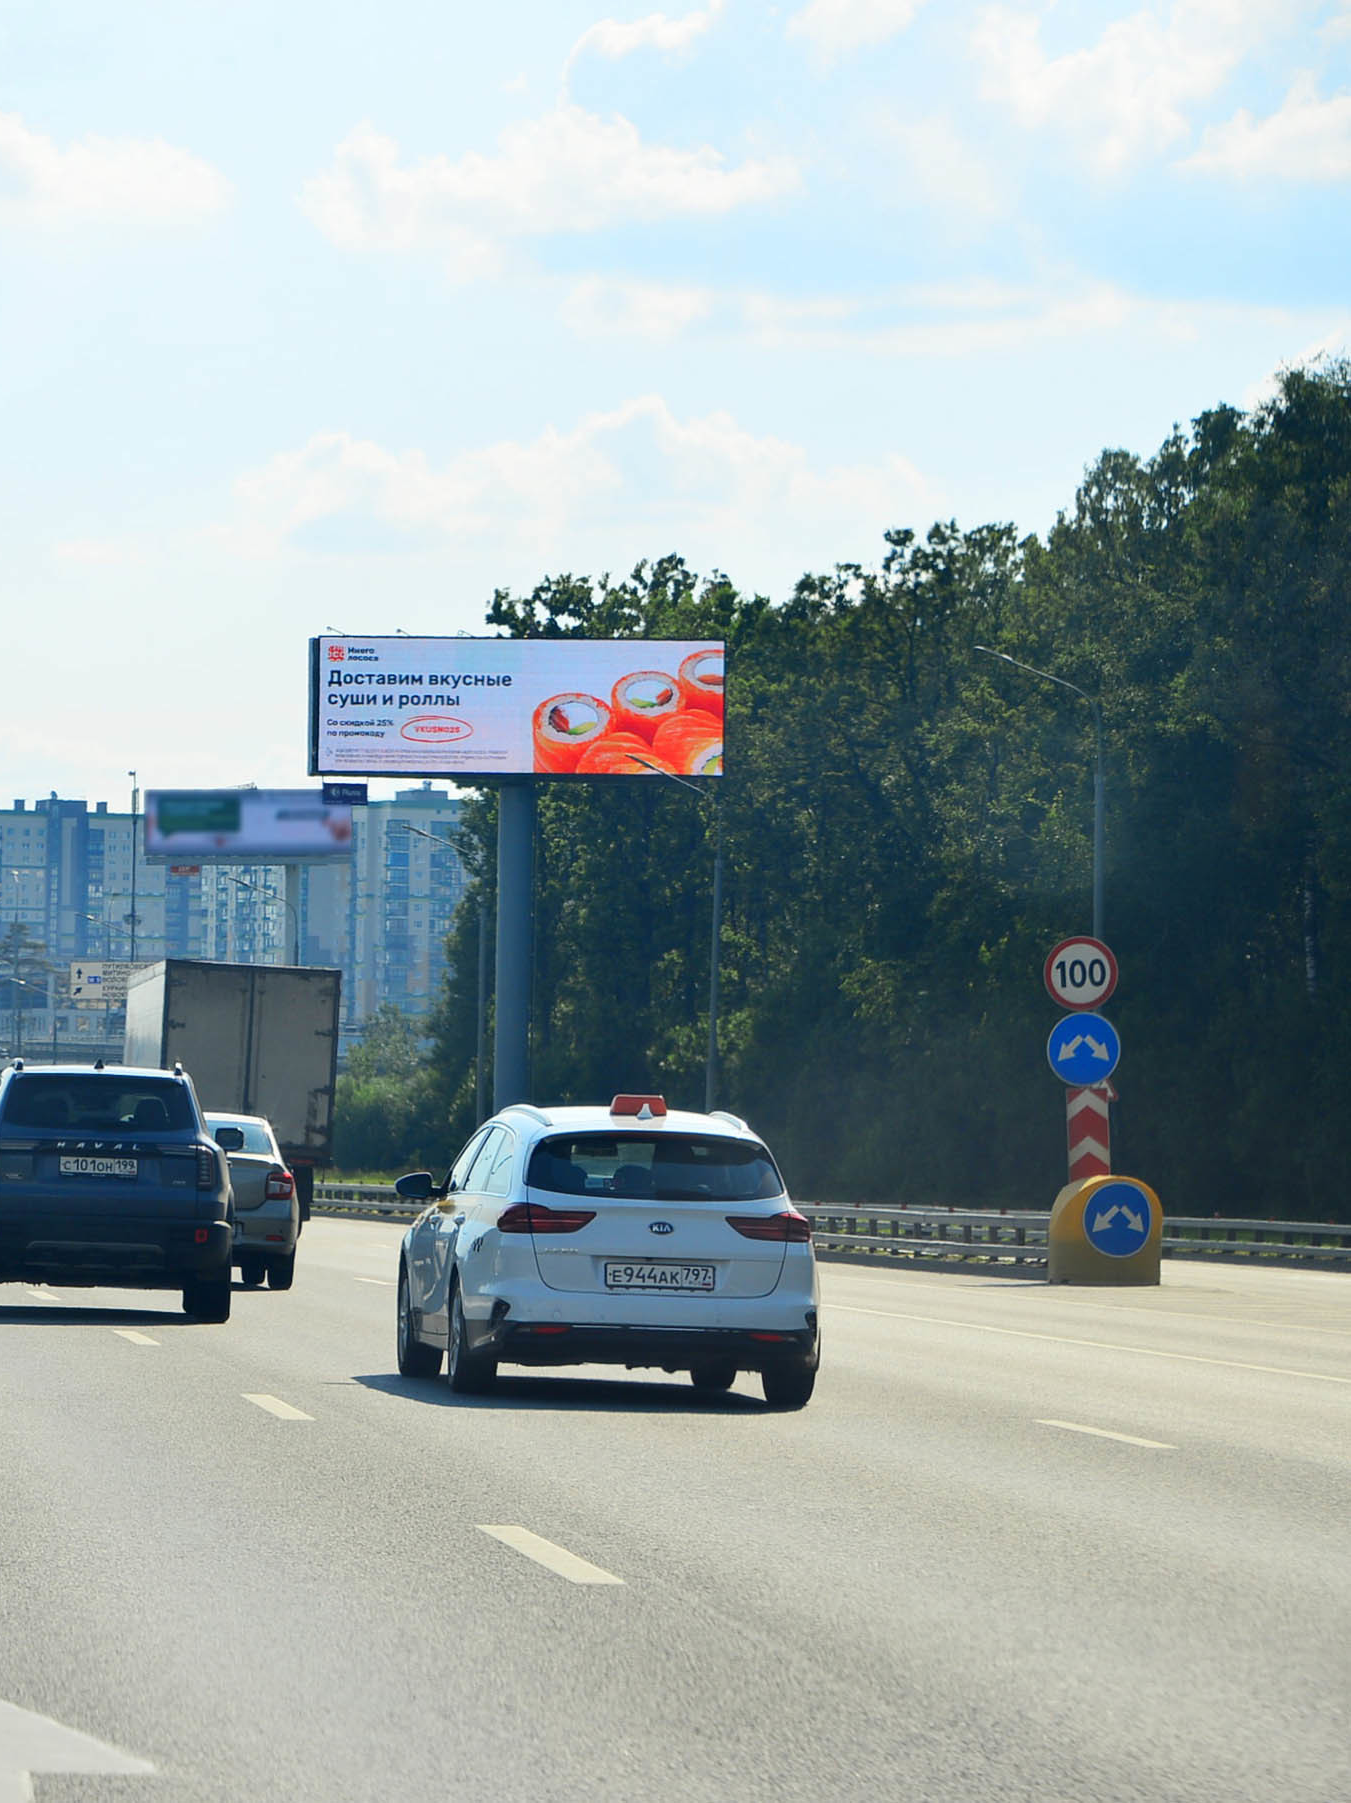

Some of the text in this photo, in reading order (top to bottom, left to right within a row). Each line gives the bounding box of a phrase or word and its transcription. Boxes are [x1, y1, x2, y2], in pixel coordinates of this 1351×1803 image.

[328, 670, 512, 689] Доставим вкусные
[328, 693, 460, 709] суши и роллы
[326, 718, 395, 728] Со скидкой 25%
[339, 730, 385, 739] промокоду
[1054, 958, 1106, 988] 100
[57, 1142, 141, 1150] HAVAL
[652, 1224, 671, 1232] KIA
